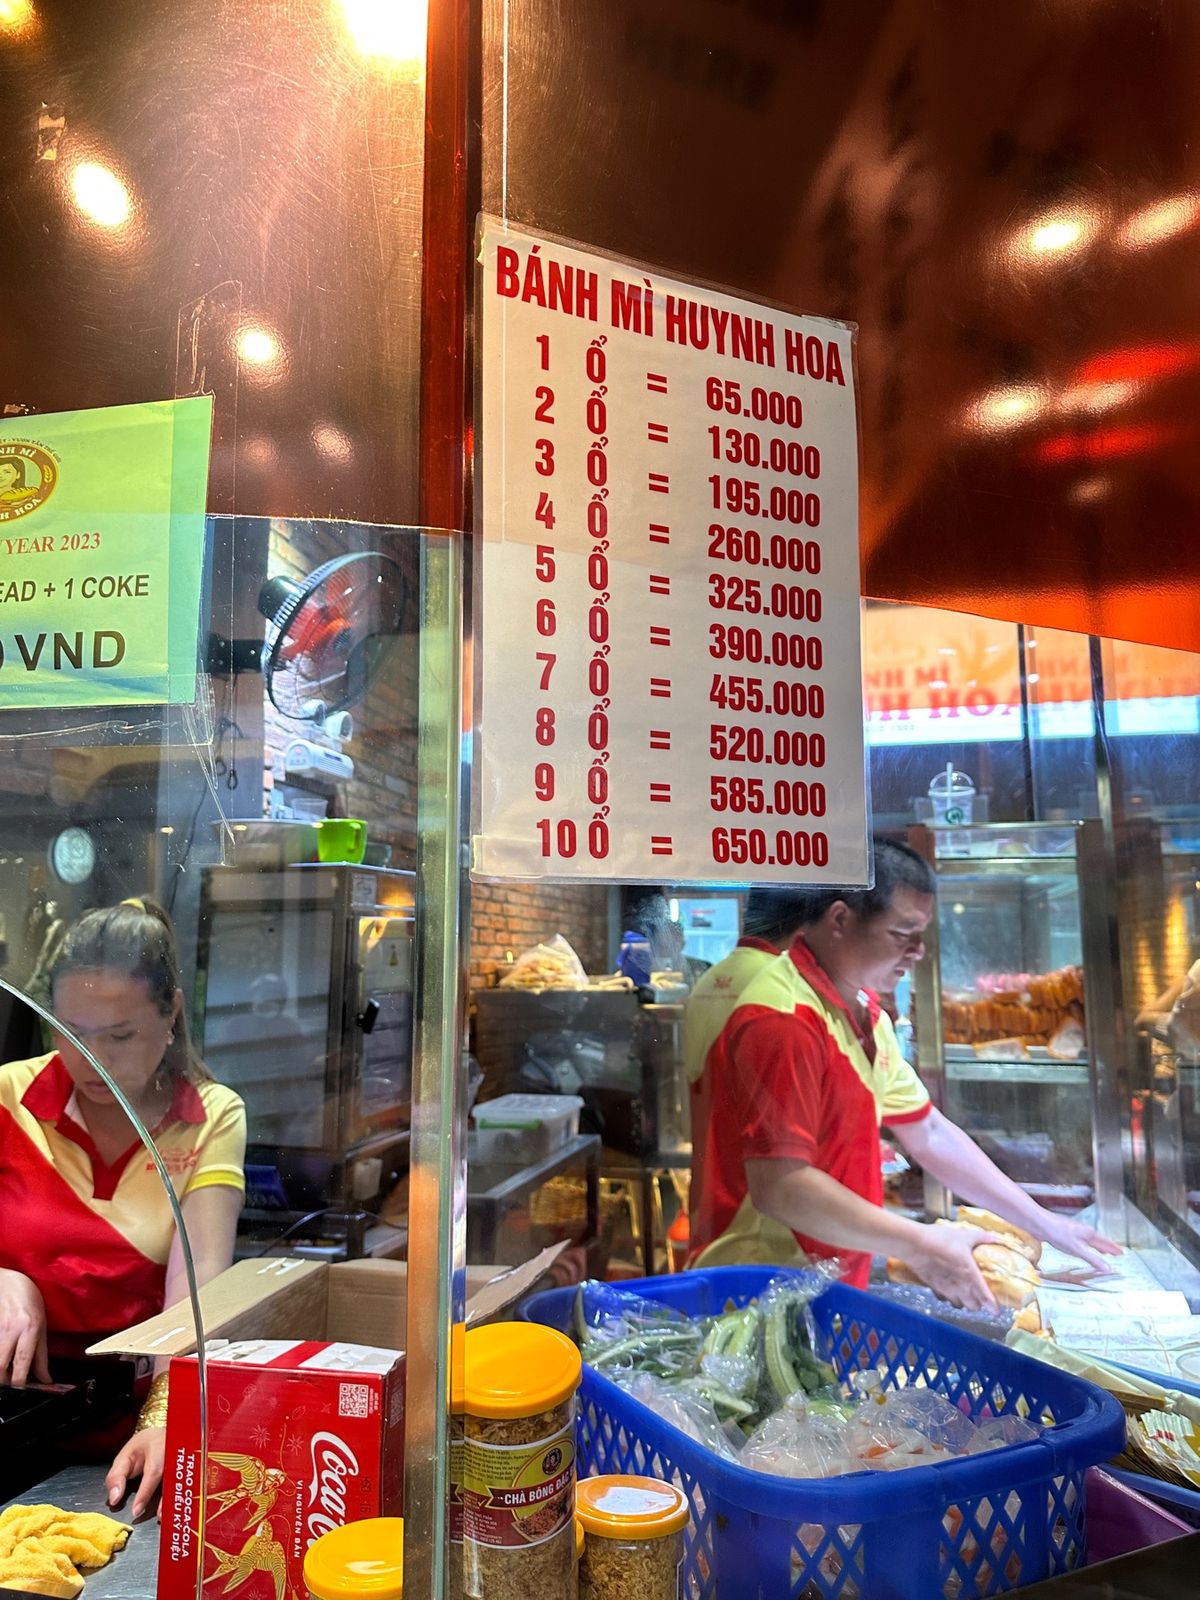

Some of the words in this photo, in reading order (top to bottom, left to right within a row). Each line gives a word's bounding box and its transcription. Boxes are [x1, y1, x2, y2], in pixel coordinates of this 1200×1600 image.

[496, 245, 598, 322] BÁNH
[611, 278, 654, 337] MÌ
[665, 295, 775, 368] HUYNH
[784, 328, 846, 387] HOA
[536, 334, 550, 371] 1
[646, 372, 668, 394] =
[706, 376, 803, 429] 65.000
[534, 385, 555, 425] 2
[647, 422, 669, 444] =
[708, 425, 821, 480] 130.000
[535, 438, 555, 477] 3
[648, 472, 669, 494] =
[708, 474, 821, 528] 195.000
[5, 535, 55, 555] YEAR
[60, 532, 101, 551] 2023
[535, 492, 556, 530] 4
[649, 523, 670, 545] =
[708, 523, 821, 575] 260.000
[64, 577, 74, 599] 1
[81, 574, 150, 599] COKE
[536, 544, 556, 583] 5
[649, 575, 670, 595] =
[708, 573, 822, 623] 325.000
[14, 630, 126, 671] VND
[536, 598, 556, 636] 6
[650, 626, 671, 647] =
[709, 623, 823, 671] 390.000
[536, 652, 557, 690] 7
[650, 678, 671, 698] =
[709, 674, 825, 719] 455.000
[536, 708, 555, 746] 8
[650, 730, 671, 750] =
[709, 724, 826, 768] 520.000
[535, 763, 555, 802] 9
[650, 783, 671, 803] =
[710, 775, 826, 817] 585.000
[536, 819, 577, 858] 10
[651, 836, 673, 855] =
[711, 827, 829, 867] 650.000
[175, 1447, 185, 1480] TRAO
[185, 1453, 195, 1487] TRAO
[295, 1493, 303, 1534] NGUYÊN
[504, 1490, 527, 1505] CHÀ
[528, 1483, 554, 1502] BÔNG
